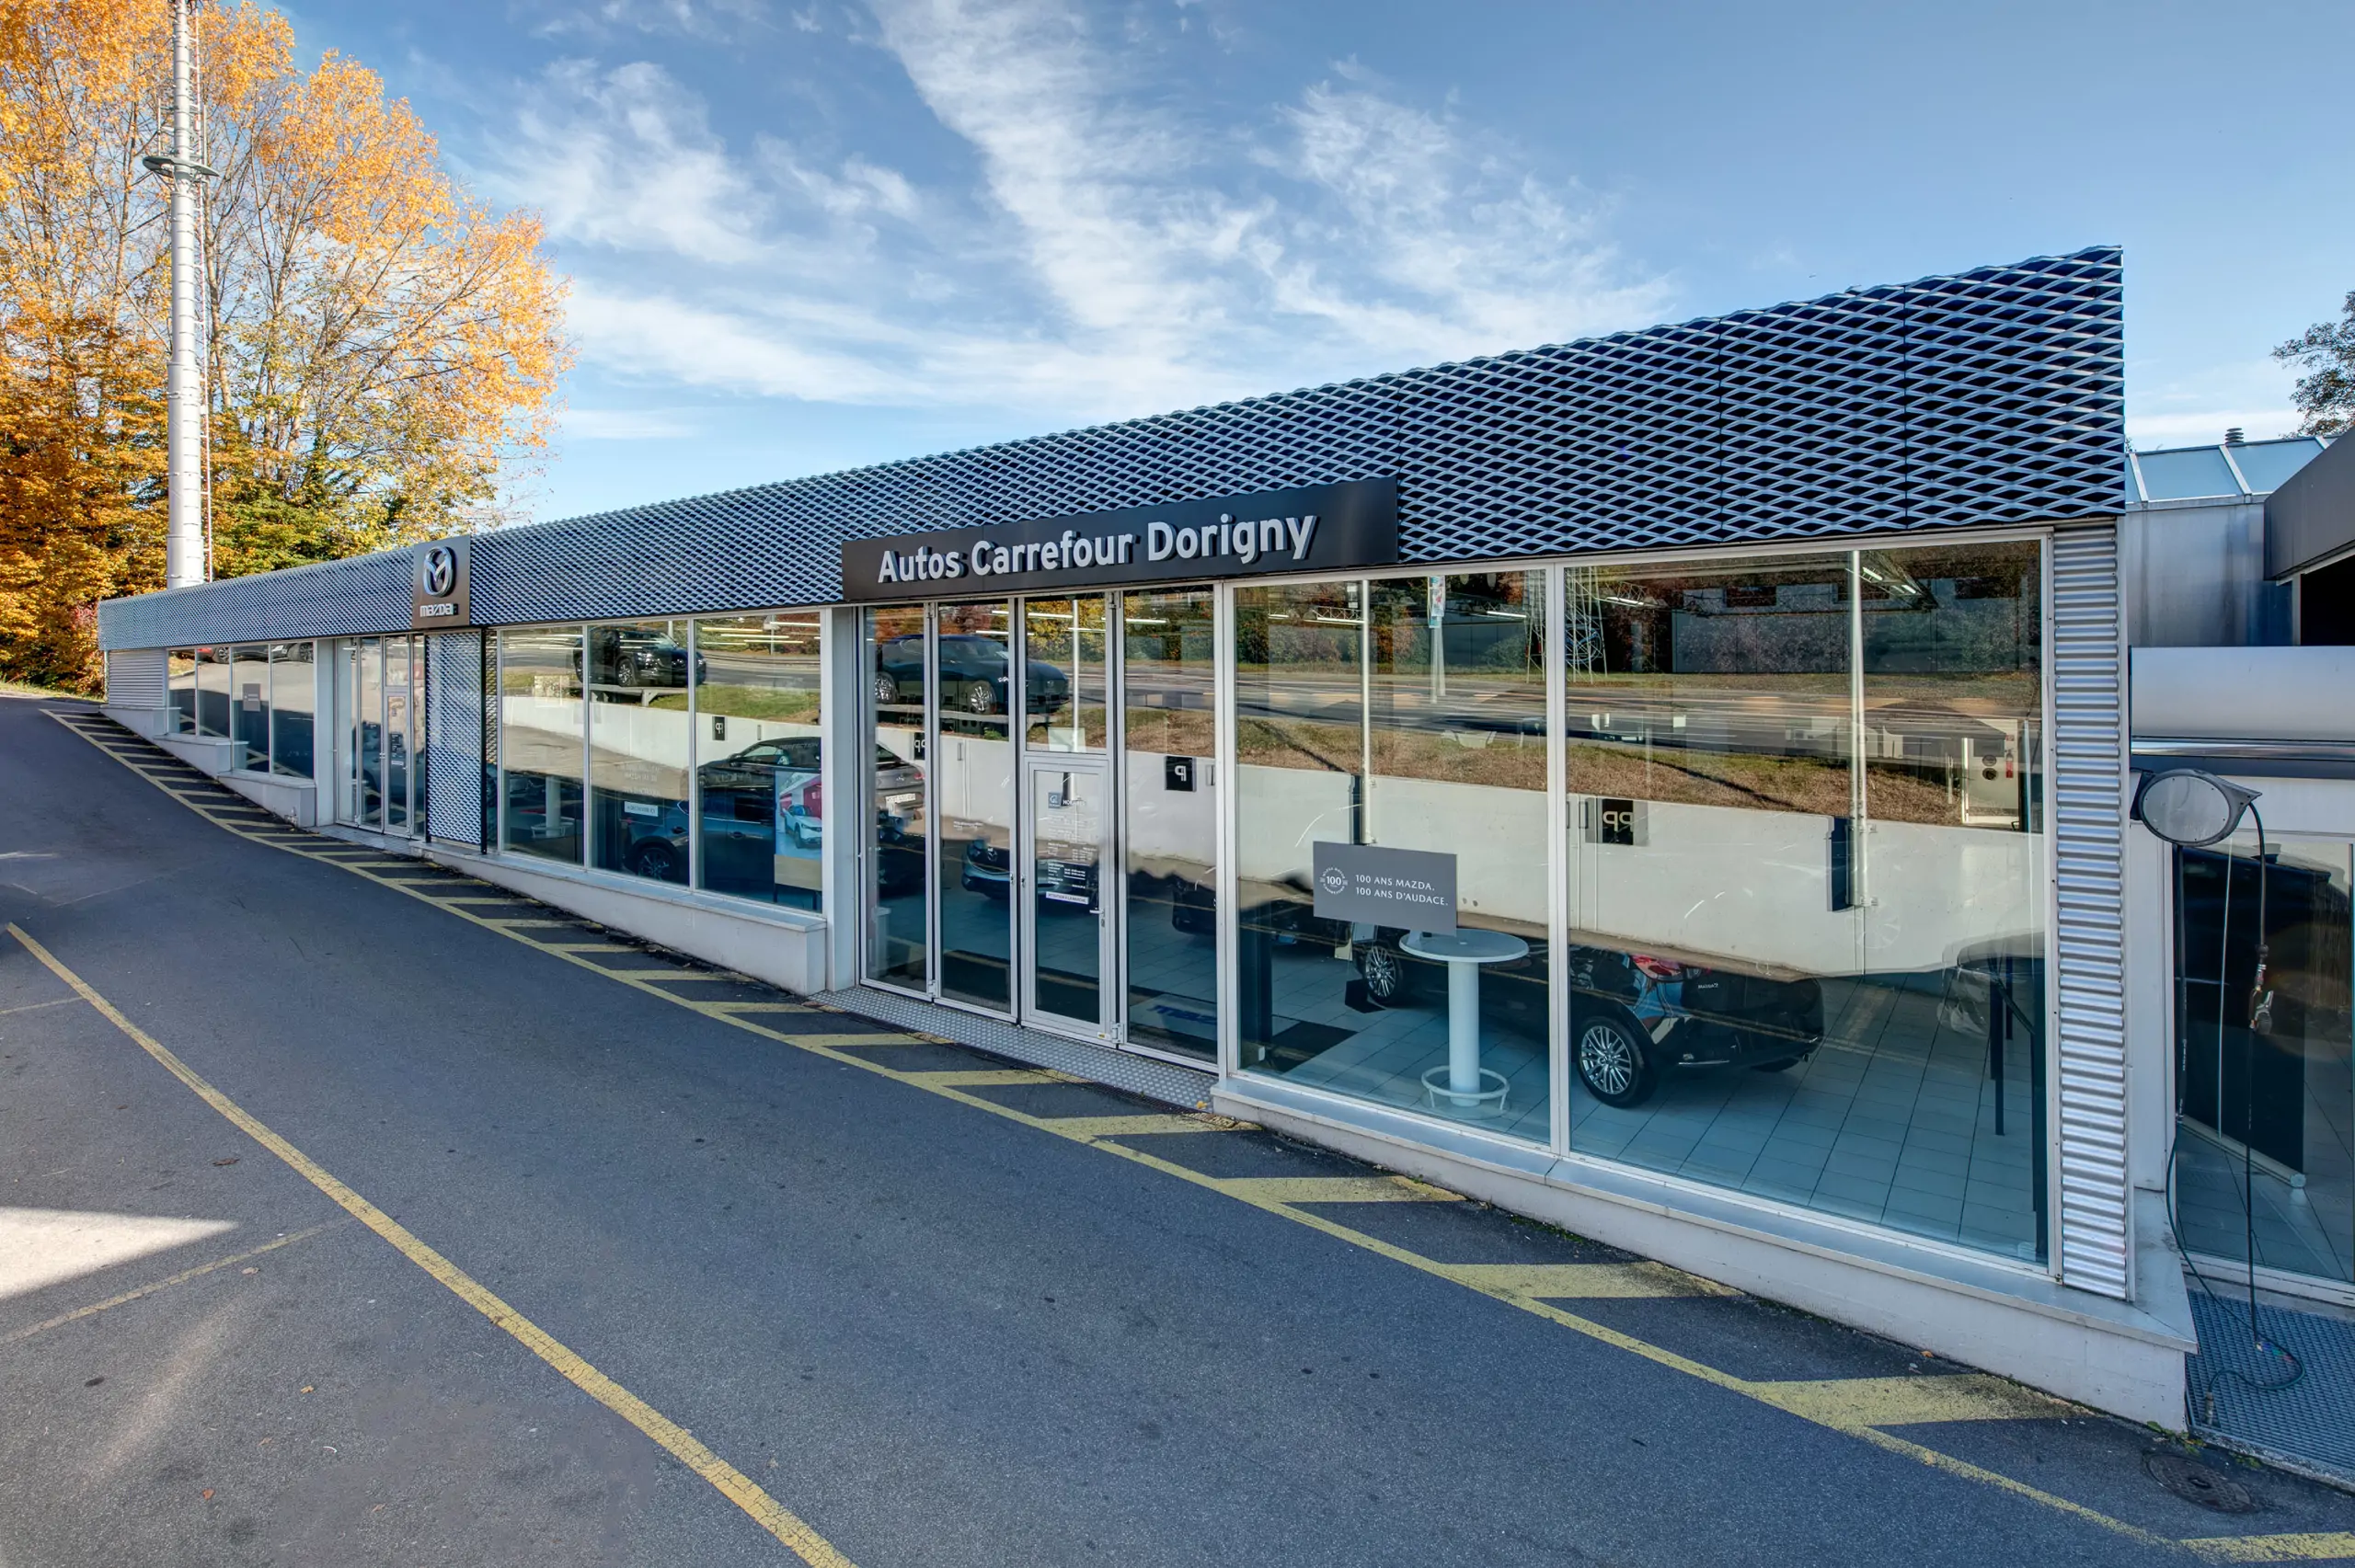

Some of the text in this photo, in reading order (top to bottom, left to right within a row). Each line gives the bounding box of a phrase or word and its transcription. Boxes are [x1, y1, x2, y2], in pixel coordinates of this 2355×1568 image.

[878, 513, 1318, 583] Autos Carrefour Dorigny
[1326, 876, 1342, 886] 100
[1355, 874, 1435, 891] 100 ANS MAZDA.
[1355, 887, 1449, 906] 100 ANS D'AUDACE.
